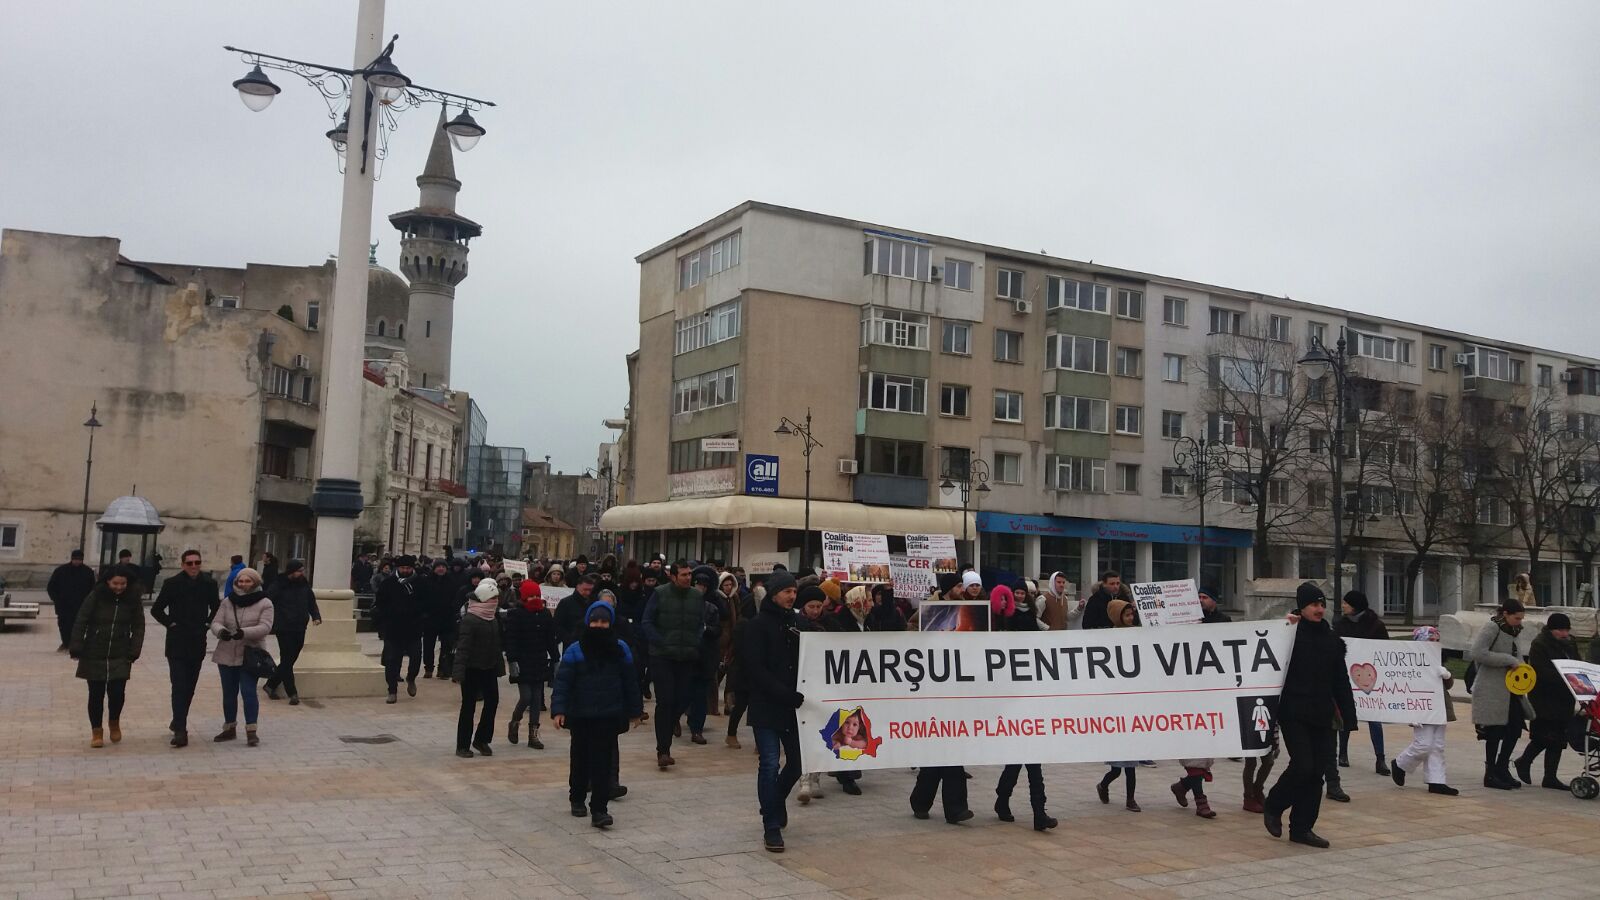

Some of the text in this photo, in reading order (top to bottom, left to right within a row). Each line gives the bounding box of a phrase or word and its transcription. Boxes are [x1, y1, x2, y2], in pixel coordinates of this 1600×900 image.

[908, 559, 930, 569] CER
[985, 644, 1141, 682] PENTRU
[1373, 651, 1431, 667] AVORTUL
[1388, 701, 1406, 710] care
[1406, 698, 1433, 711] BATE
[889, 716, 969, 739] ROMÂNIA
[973, 715, 1046, 737] PLÂNGE
[1051, 716, 1125, 735] PRUNCII
